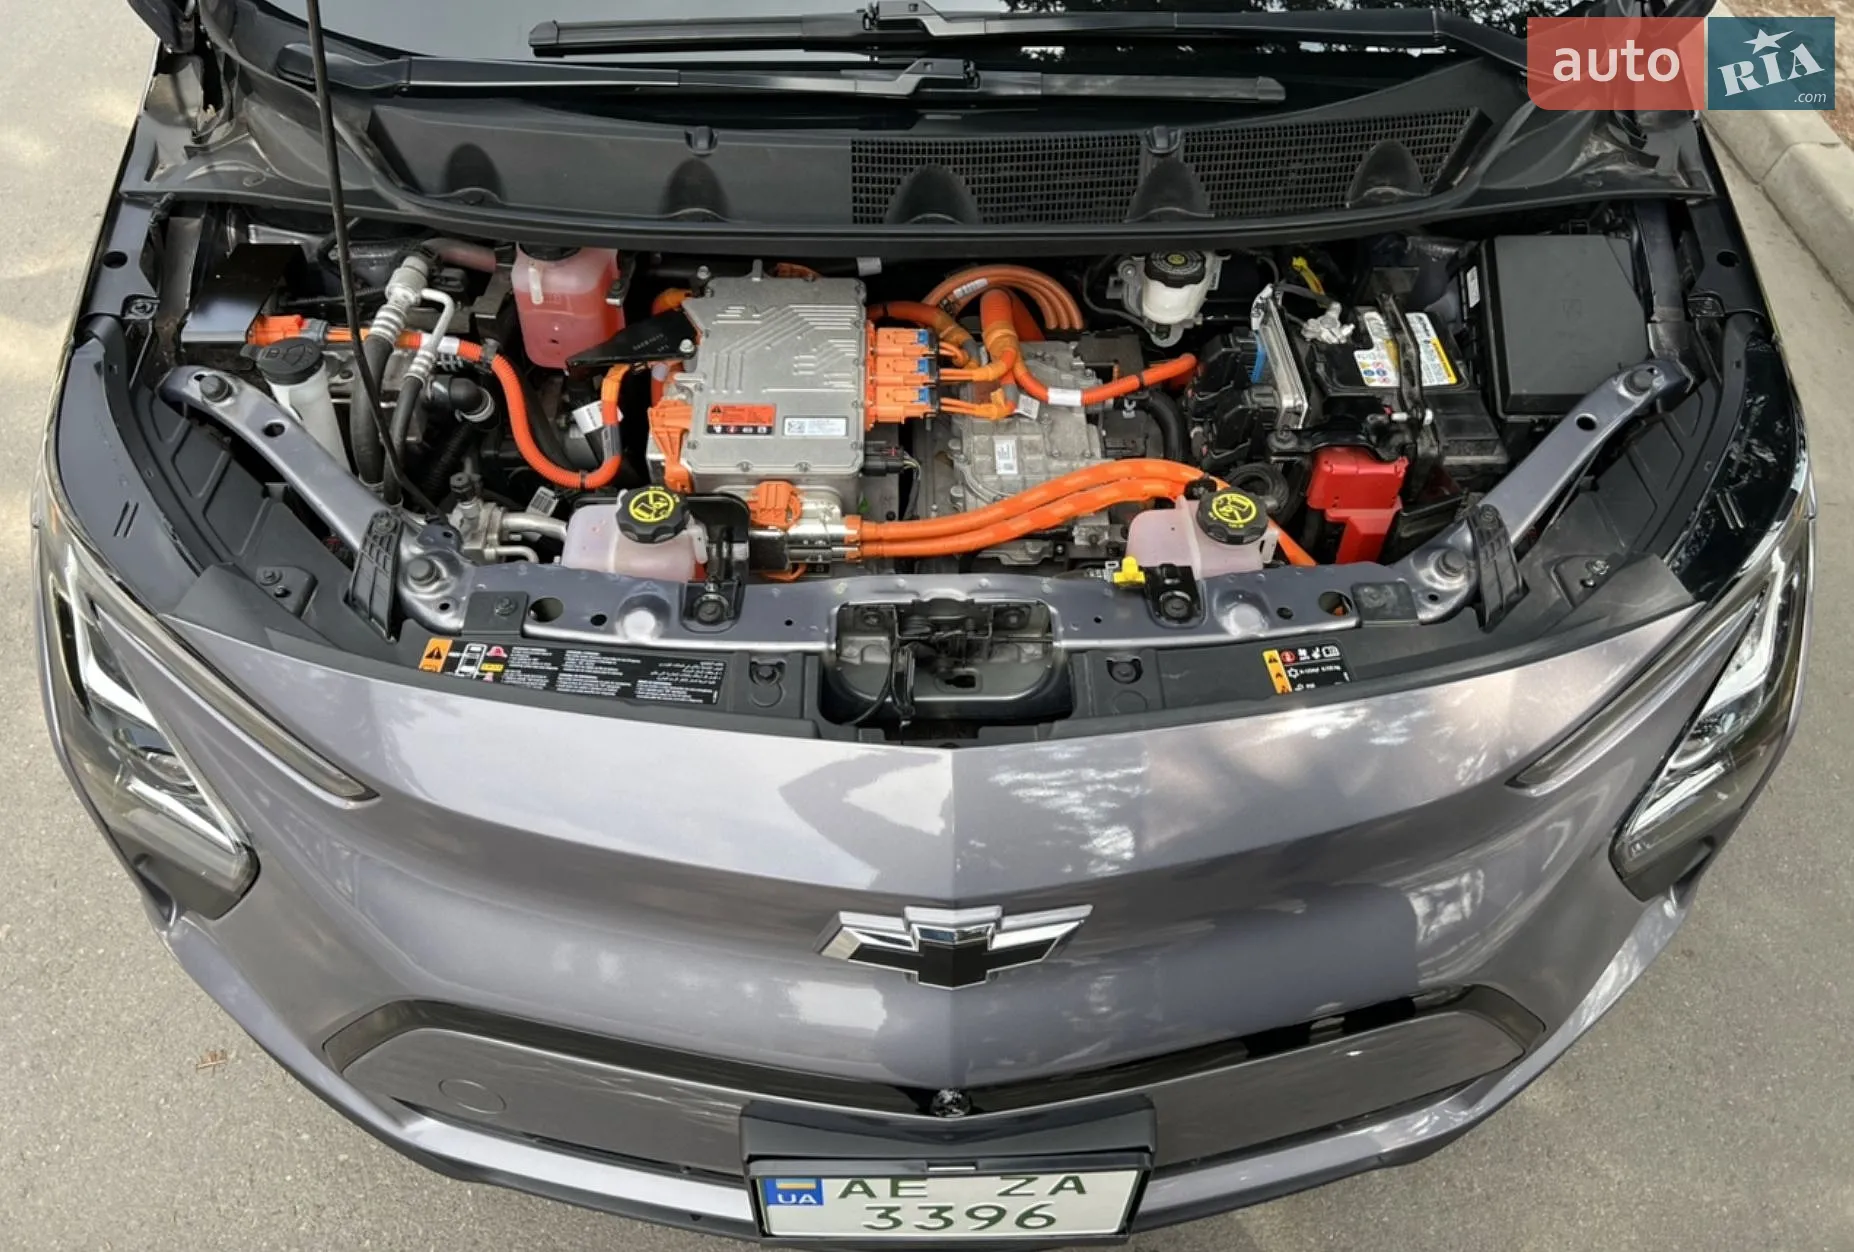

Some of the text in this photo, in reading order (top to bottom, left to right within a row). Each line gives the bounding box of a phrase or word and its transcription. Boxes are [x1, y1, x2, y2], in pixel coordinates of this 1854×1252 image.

[777, 1193, 817, 1204] UA
[838, 1175, 1086, 1199] AE ZA
[862, 1203, 1057, 1231] 3396
